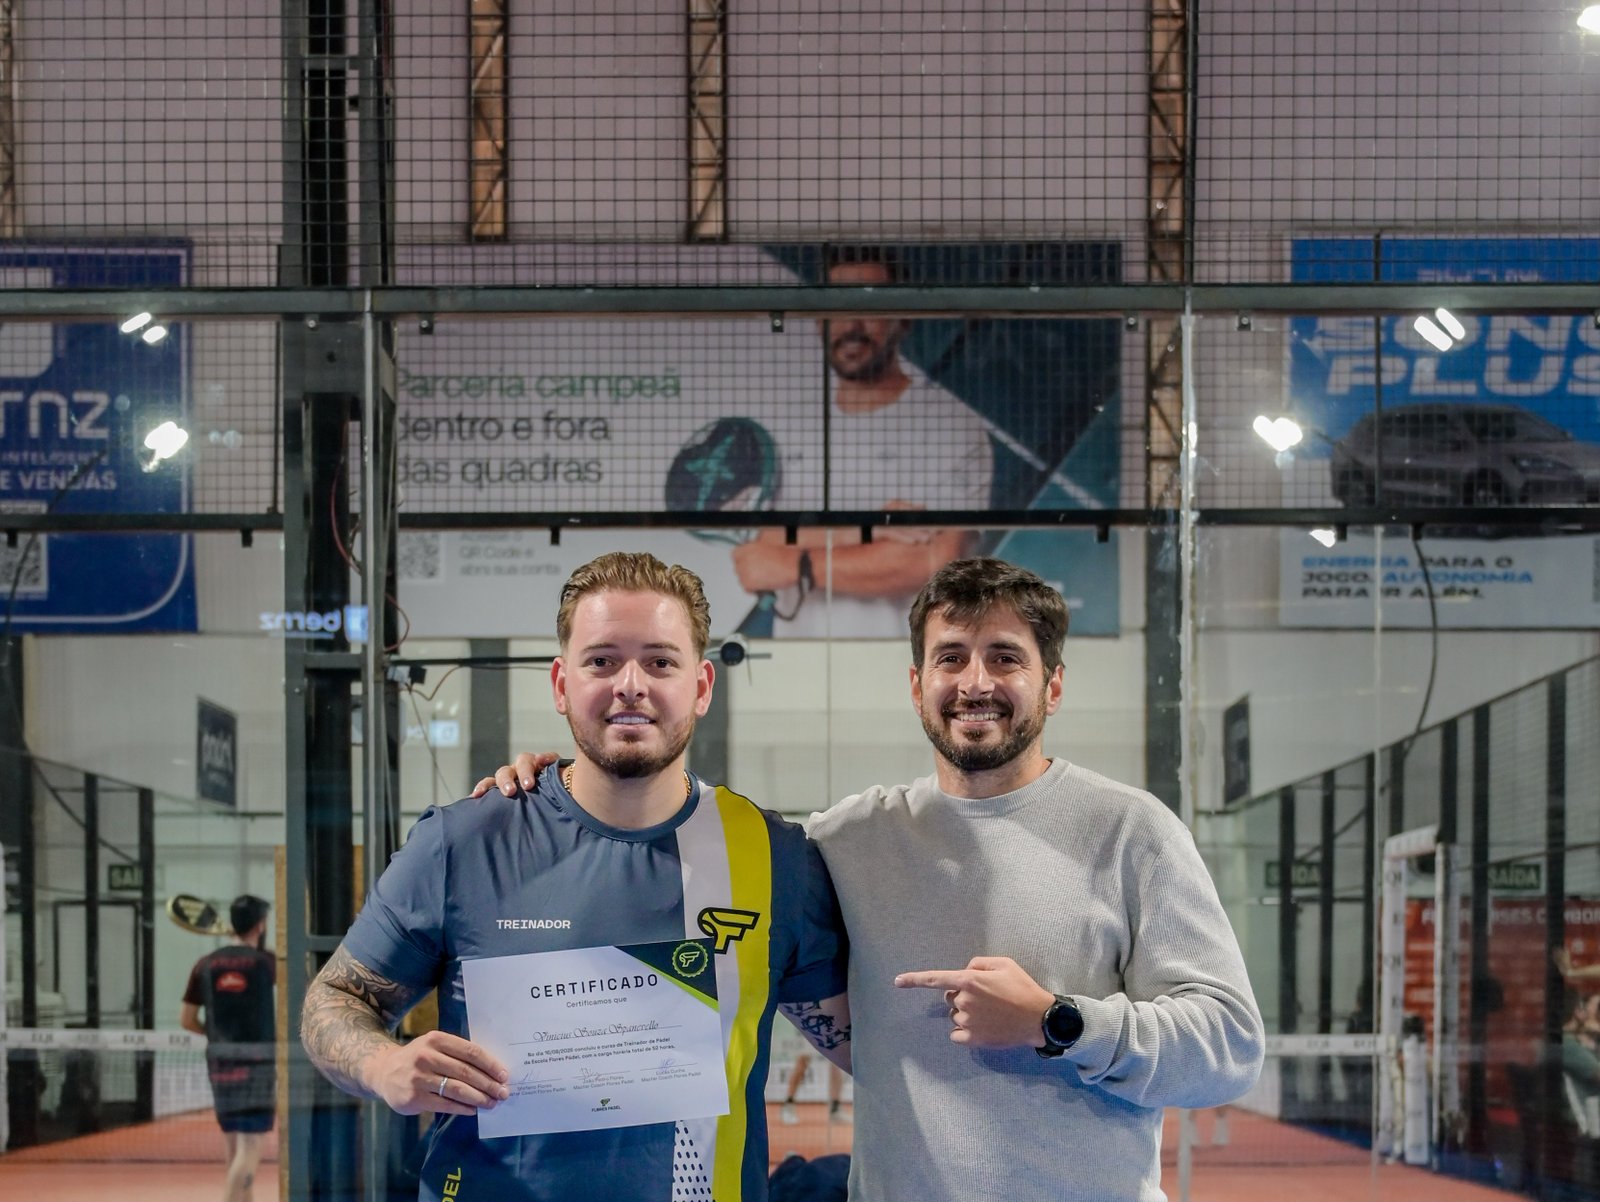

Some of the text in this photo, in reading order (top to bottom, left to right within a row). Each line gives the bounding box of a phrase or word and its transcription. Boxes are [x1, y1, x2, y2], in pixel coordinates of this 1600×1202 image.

[1313, 316, 1600, 352] SON
[535, 368, 680, 403] campeã
[512, 418, 533, 441] e
[544, 411, 611, 441] fora
[19, 470, 117, 490] VENDAS
[461, 455, 602, 490] quadras
[1418, 556, 1486, 568] PARA
[1495, 556, 1514, 568] O
[1383, 571, 1533, 584] AUTONOMIA
[1302, 587, 1370, 598] PARA
[496, 919, 571, 929] TREINADOR
[530, 973, 658, 999] CERTIFICADO
[566, 997, 612, 1008] Certificamos
